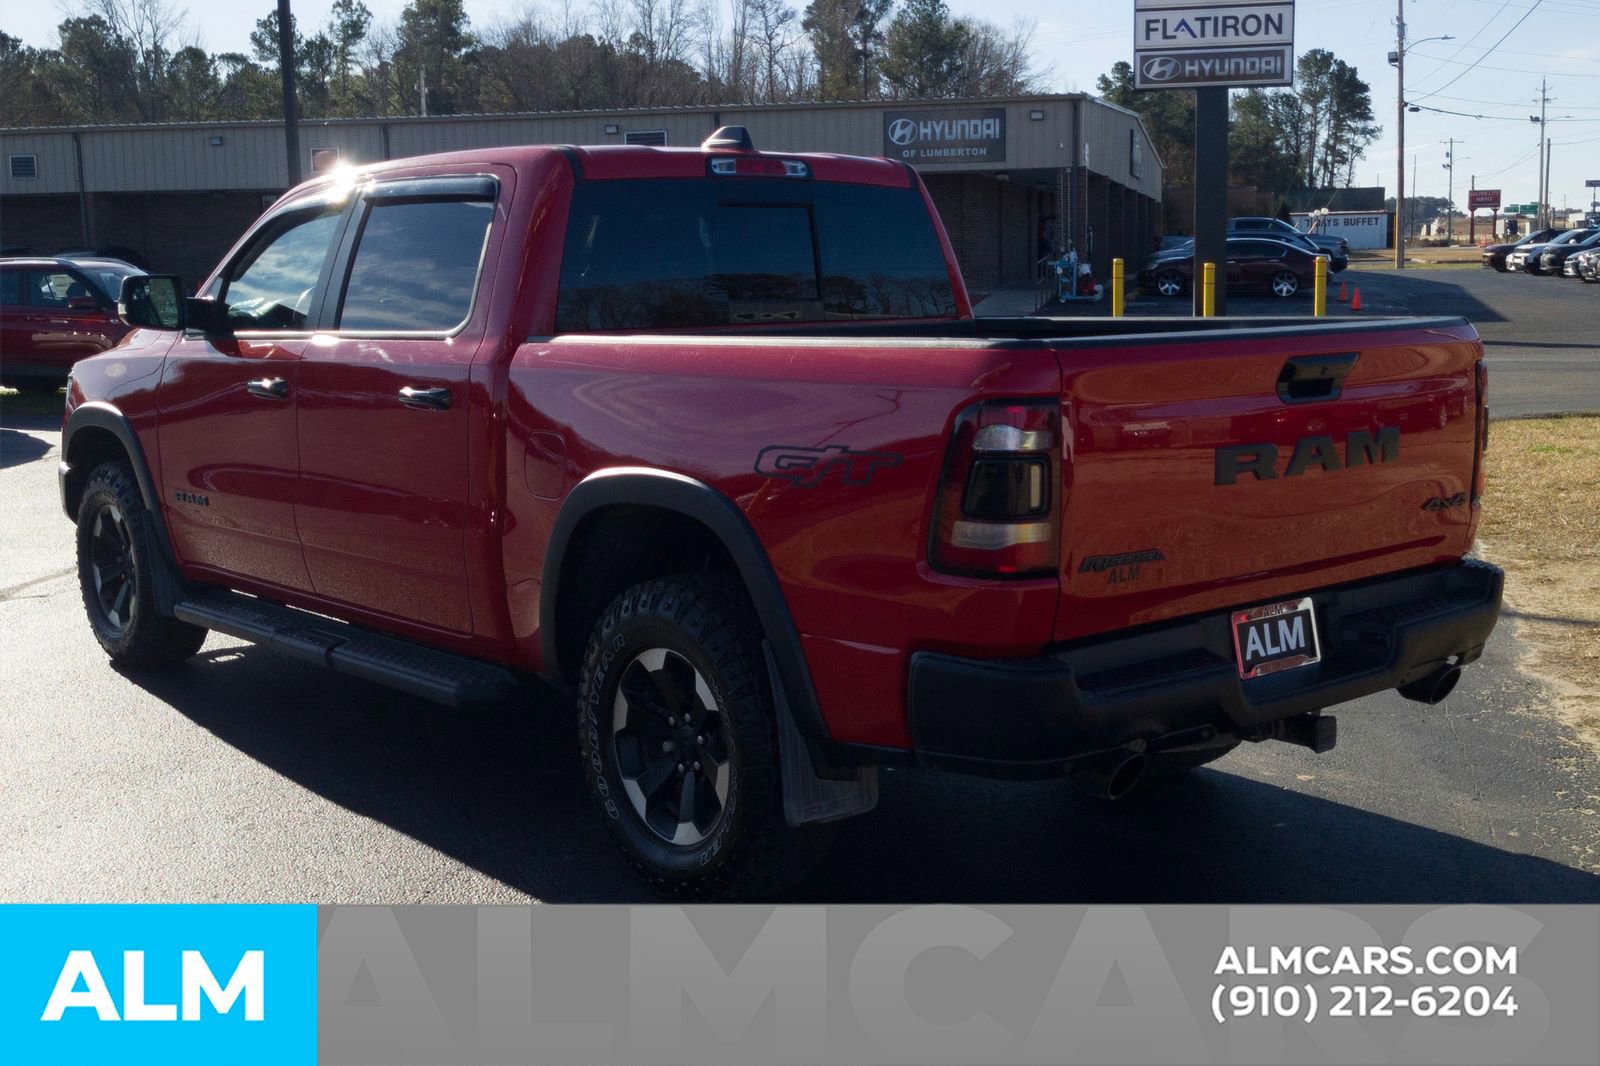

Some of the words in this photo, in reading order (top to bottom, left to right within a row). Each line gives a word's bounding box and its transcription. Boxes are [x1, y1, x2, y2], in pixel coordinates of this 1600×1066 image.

[1144, 13, 1284, 41] FLATIRON
[1184, 56, 1282, 77] HYUNDAI
[919, 118, 1000, 141] HYUNDAI
[902, 149, 918, 158] OF
[920, 147, 987, 157] LUMBERTON
[1343, 217, 1380, 227] BUFFET
[1214, 426, 1401, 486] RAM
[1079, 548, 1166, 573] REBEL
[1108, 565, 1140, 584] ALM
[1263, 604, 1284, 617] ALM
[1245, 616, 1306, 661] ALM
[588, 633, 625, 820] GOODYEAR
